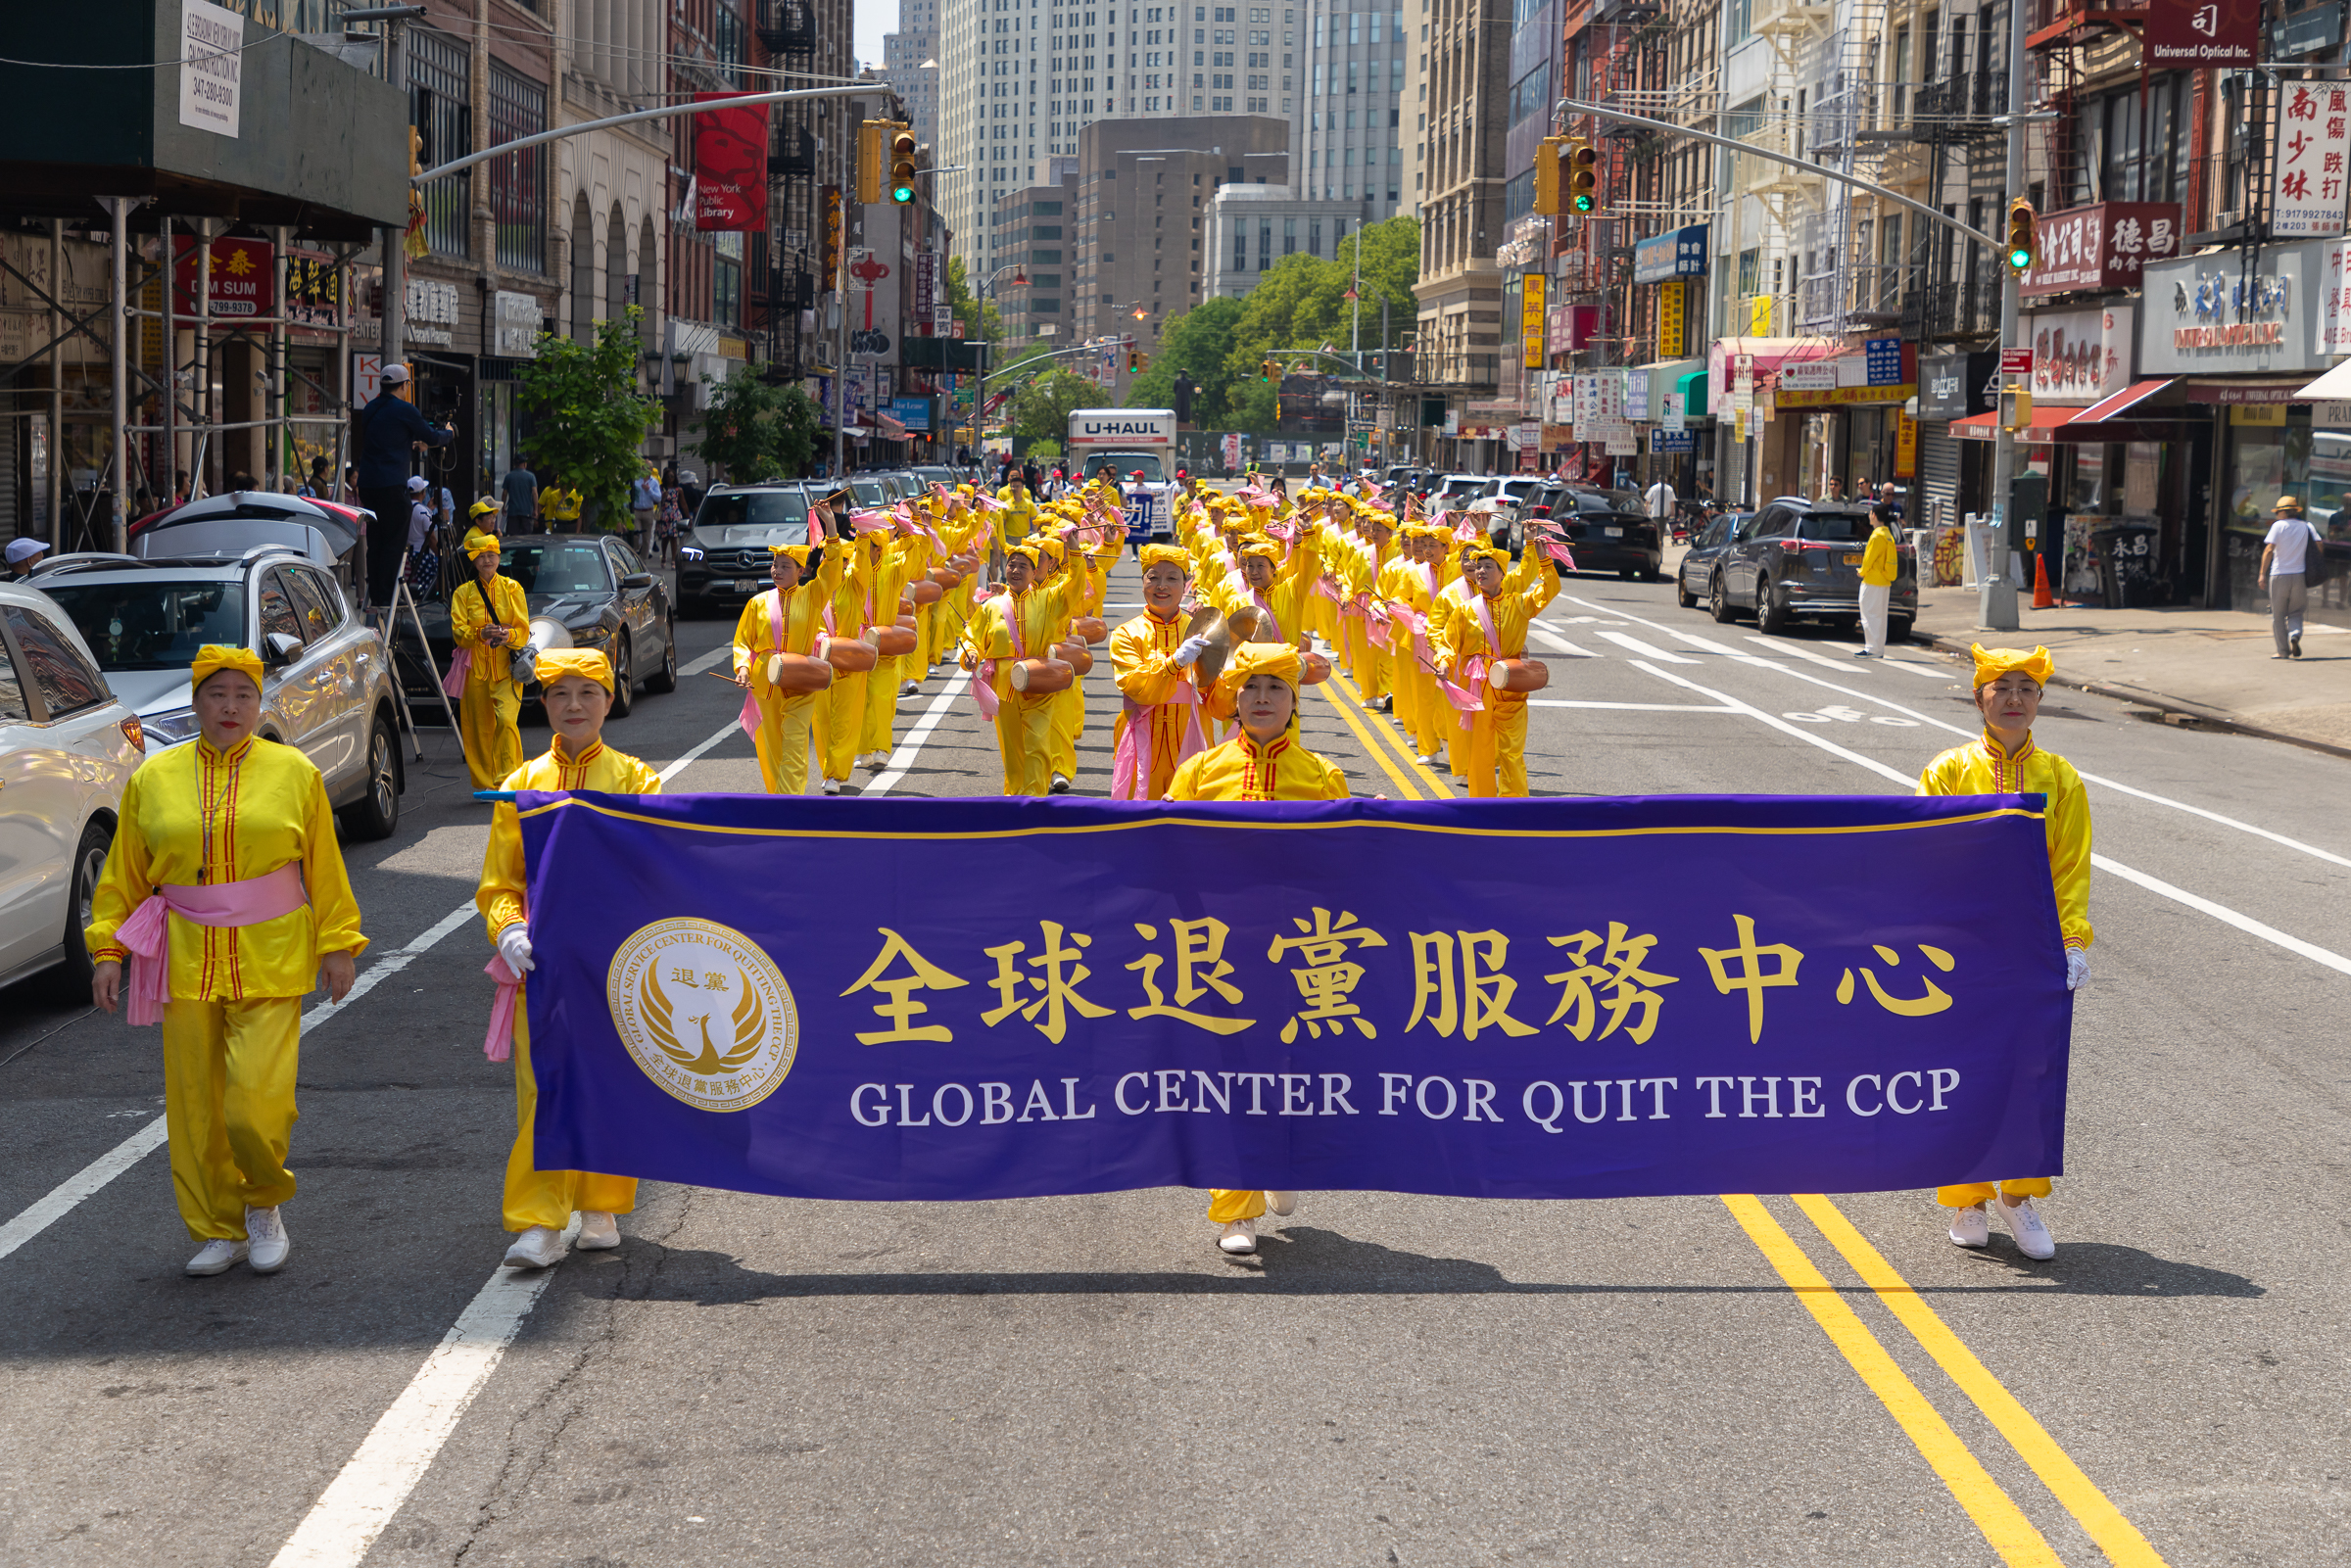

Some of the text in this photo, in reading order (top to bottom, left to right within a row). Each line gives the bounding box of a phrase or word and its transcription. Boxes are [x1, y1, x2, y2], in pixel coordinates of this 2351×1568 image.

[2191, 4, 2217, 37] 司
[196, 46, 230, 80] CONSTRUCTION
[2154, 44, 2251, 60] Universal Optical Inc.
[193, 76, 233, 107] 347-280-9300
[2281, 87, 2318, 202] 南少林
[2323, 90, 2347, 200] 風傷 跌打
[699, 183, 742, 195] New York
[699, 196, 724, 206] Public
[699, 208, 735, 219] Library
[2276, 209, 2344, 220] T:9179927843
[2110, 216, 2175, 255] 德昌
[224, 281, 256, 295] SUM
[289, 256, 353, 307] 海鮮酒
[354, 320, 381, 339] ENTER
[1524, 279, 1543, 363] 東英商場
[1085, 422, 1160, 434] U-HAUL
[2111, 534, 2149, 558] 永昌
[670, 967, 730, 992] 退黨
[840, 906, 1954, 1045] 全球退黨服務中心
[622, 932, 783, 1062] GLOBAL SERVICE CENTER FOR QUITTING THE CCP
[648, 1053, 766, 1097] 全球退黨服務中心
[850, 1068, 1959, 1133] GLOBAL CENTER FOR QUIT THE CCP
